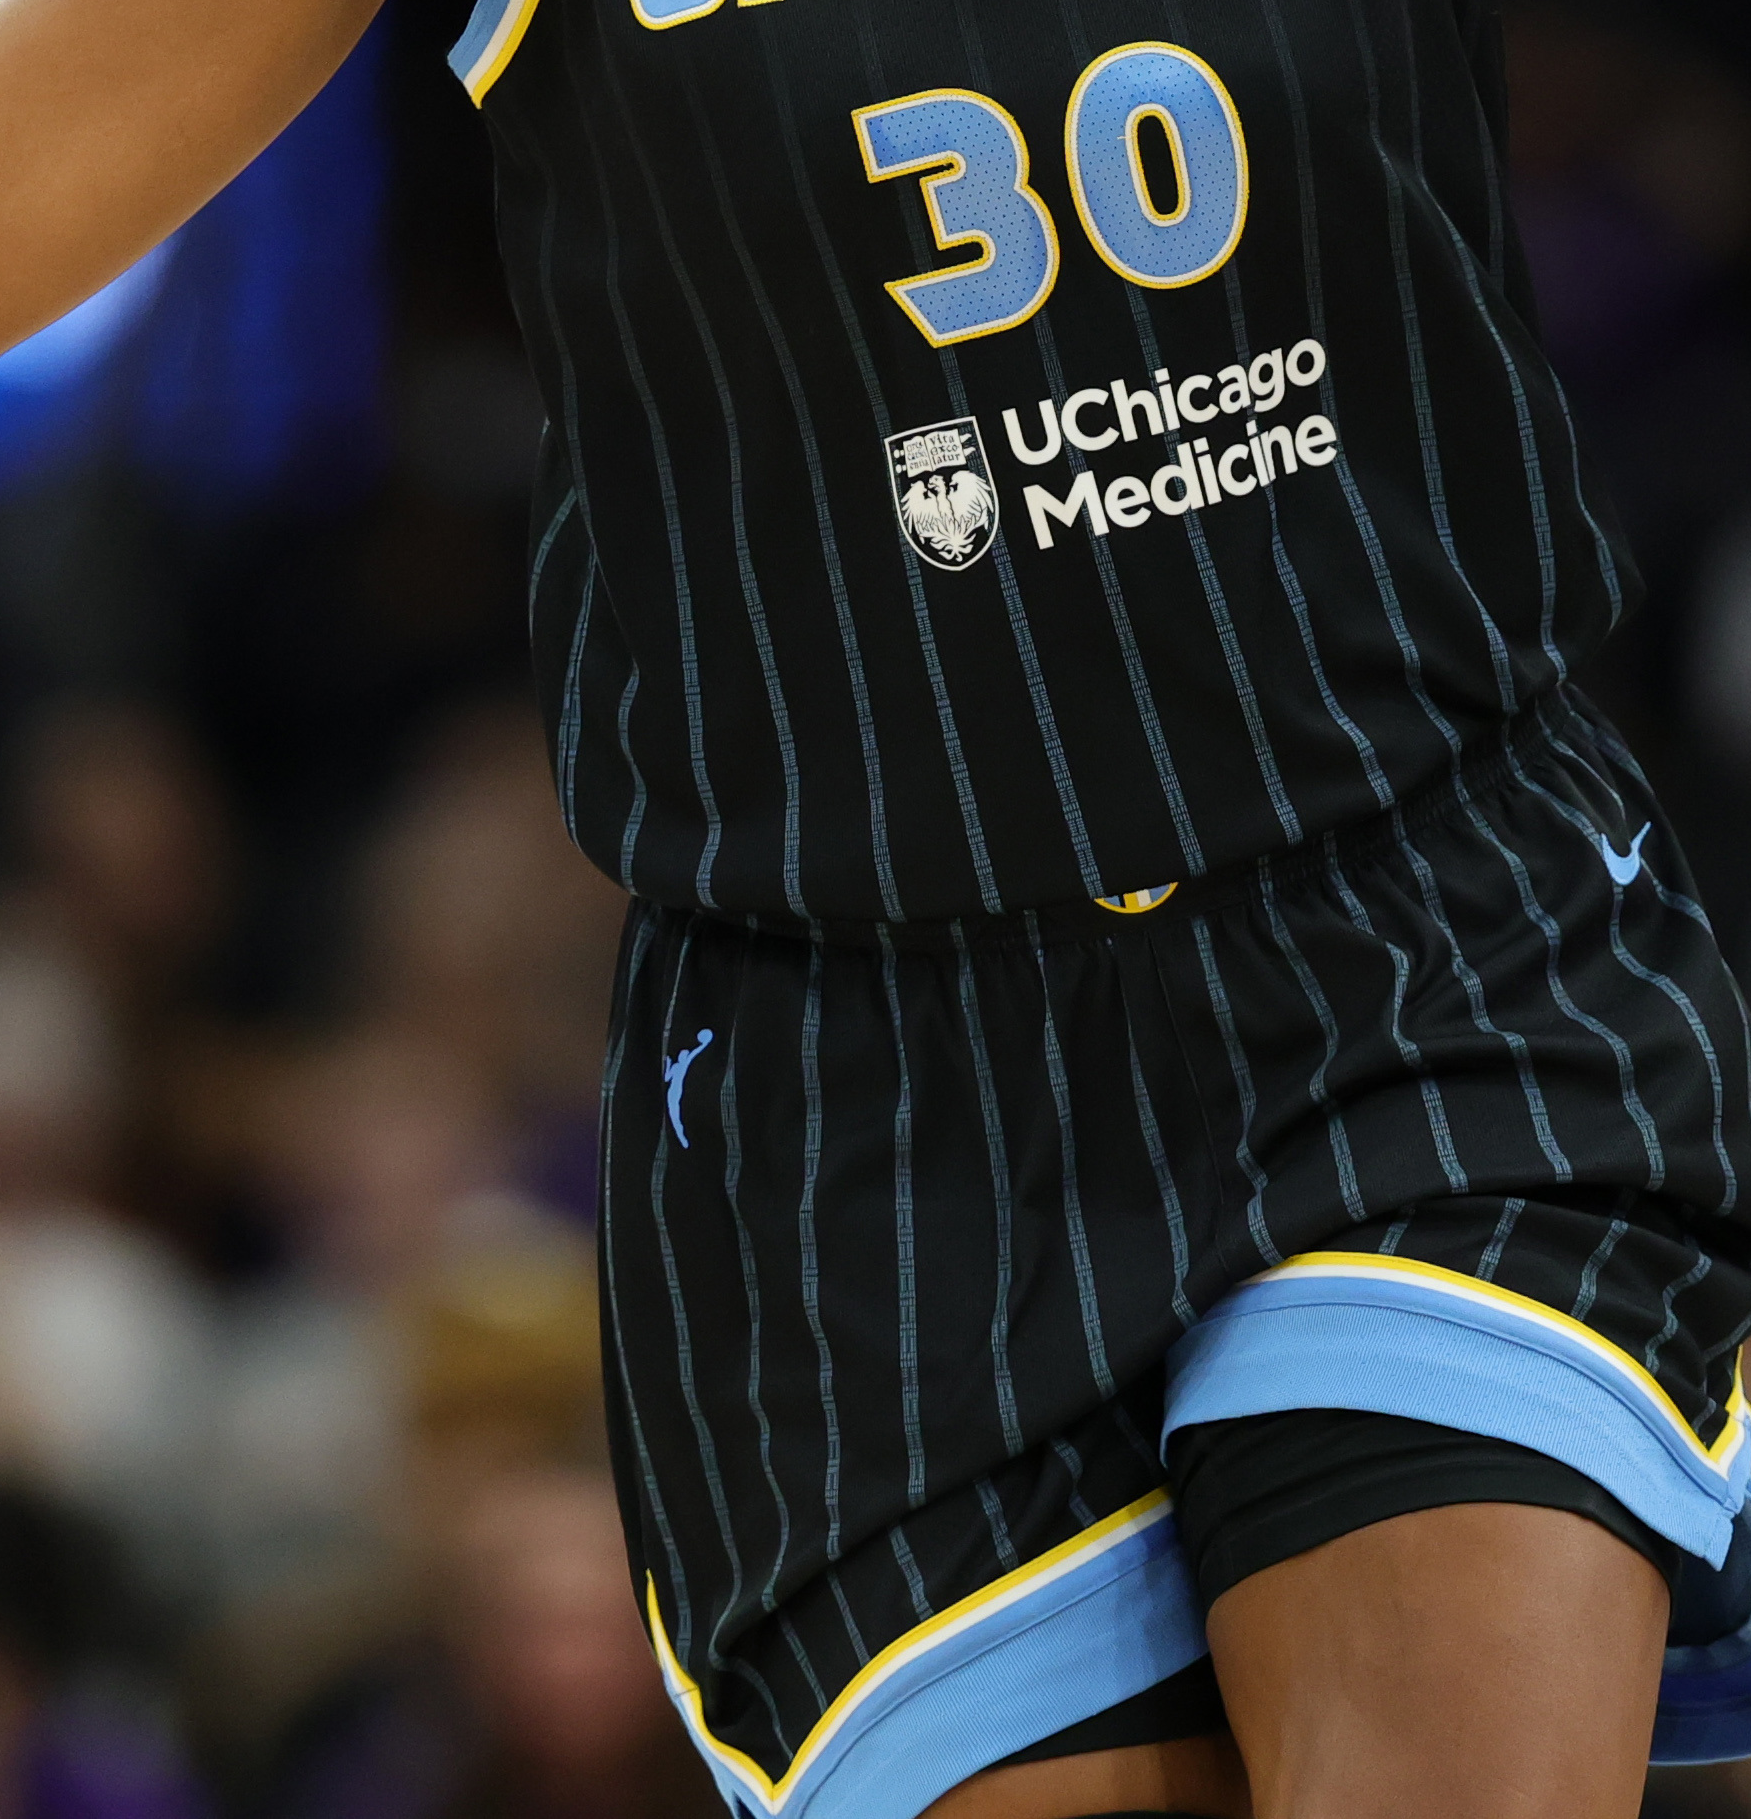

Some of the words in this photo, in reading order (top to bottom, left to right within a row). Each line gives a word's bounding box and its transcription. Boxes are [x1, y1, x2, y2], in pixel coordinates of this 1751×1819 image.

[850, 39, 1250, 349] 30
[1001, 337, 1328, 466] UChicago
[1022, 412, 1338, 551] Medicine
